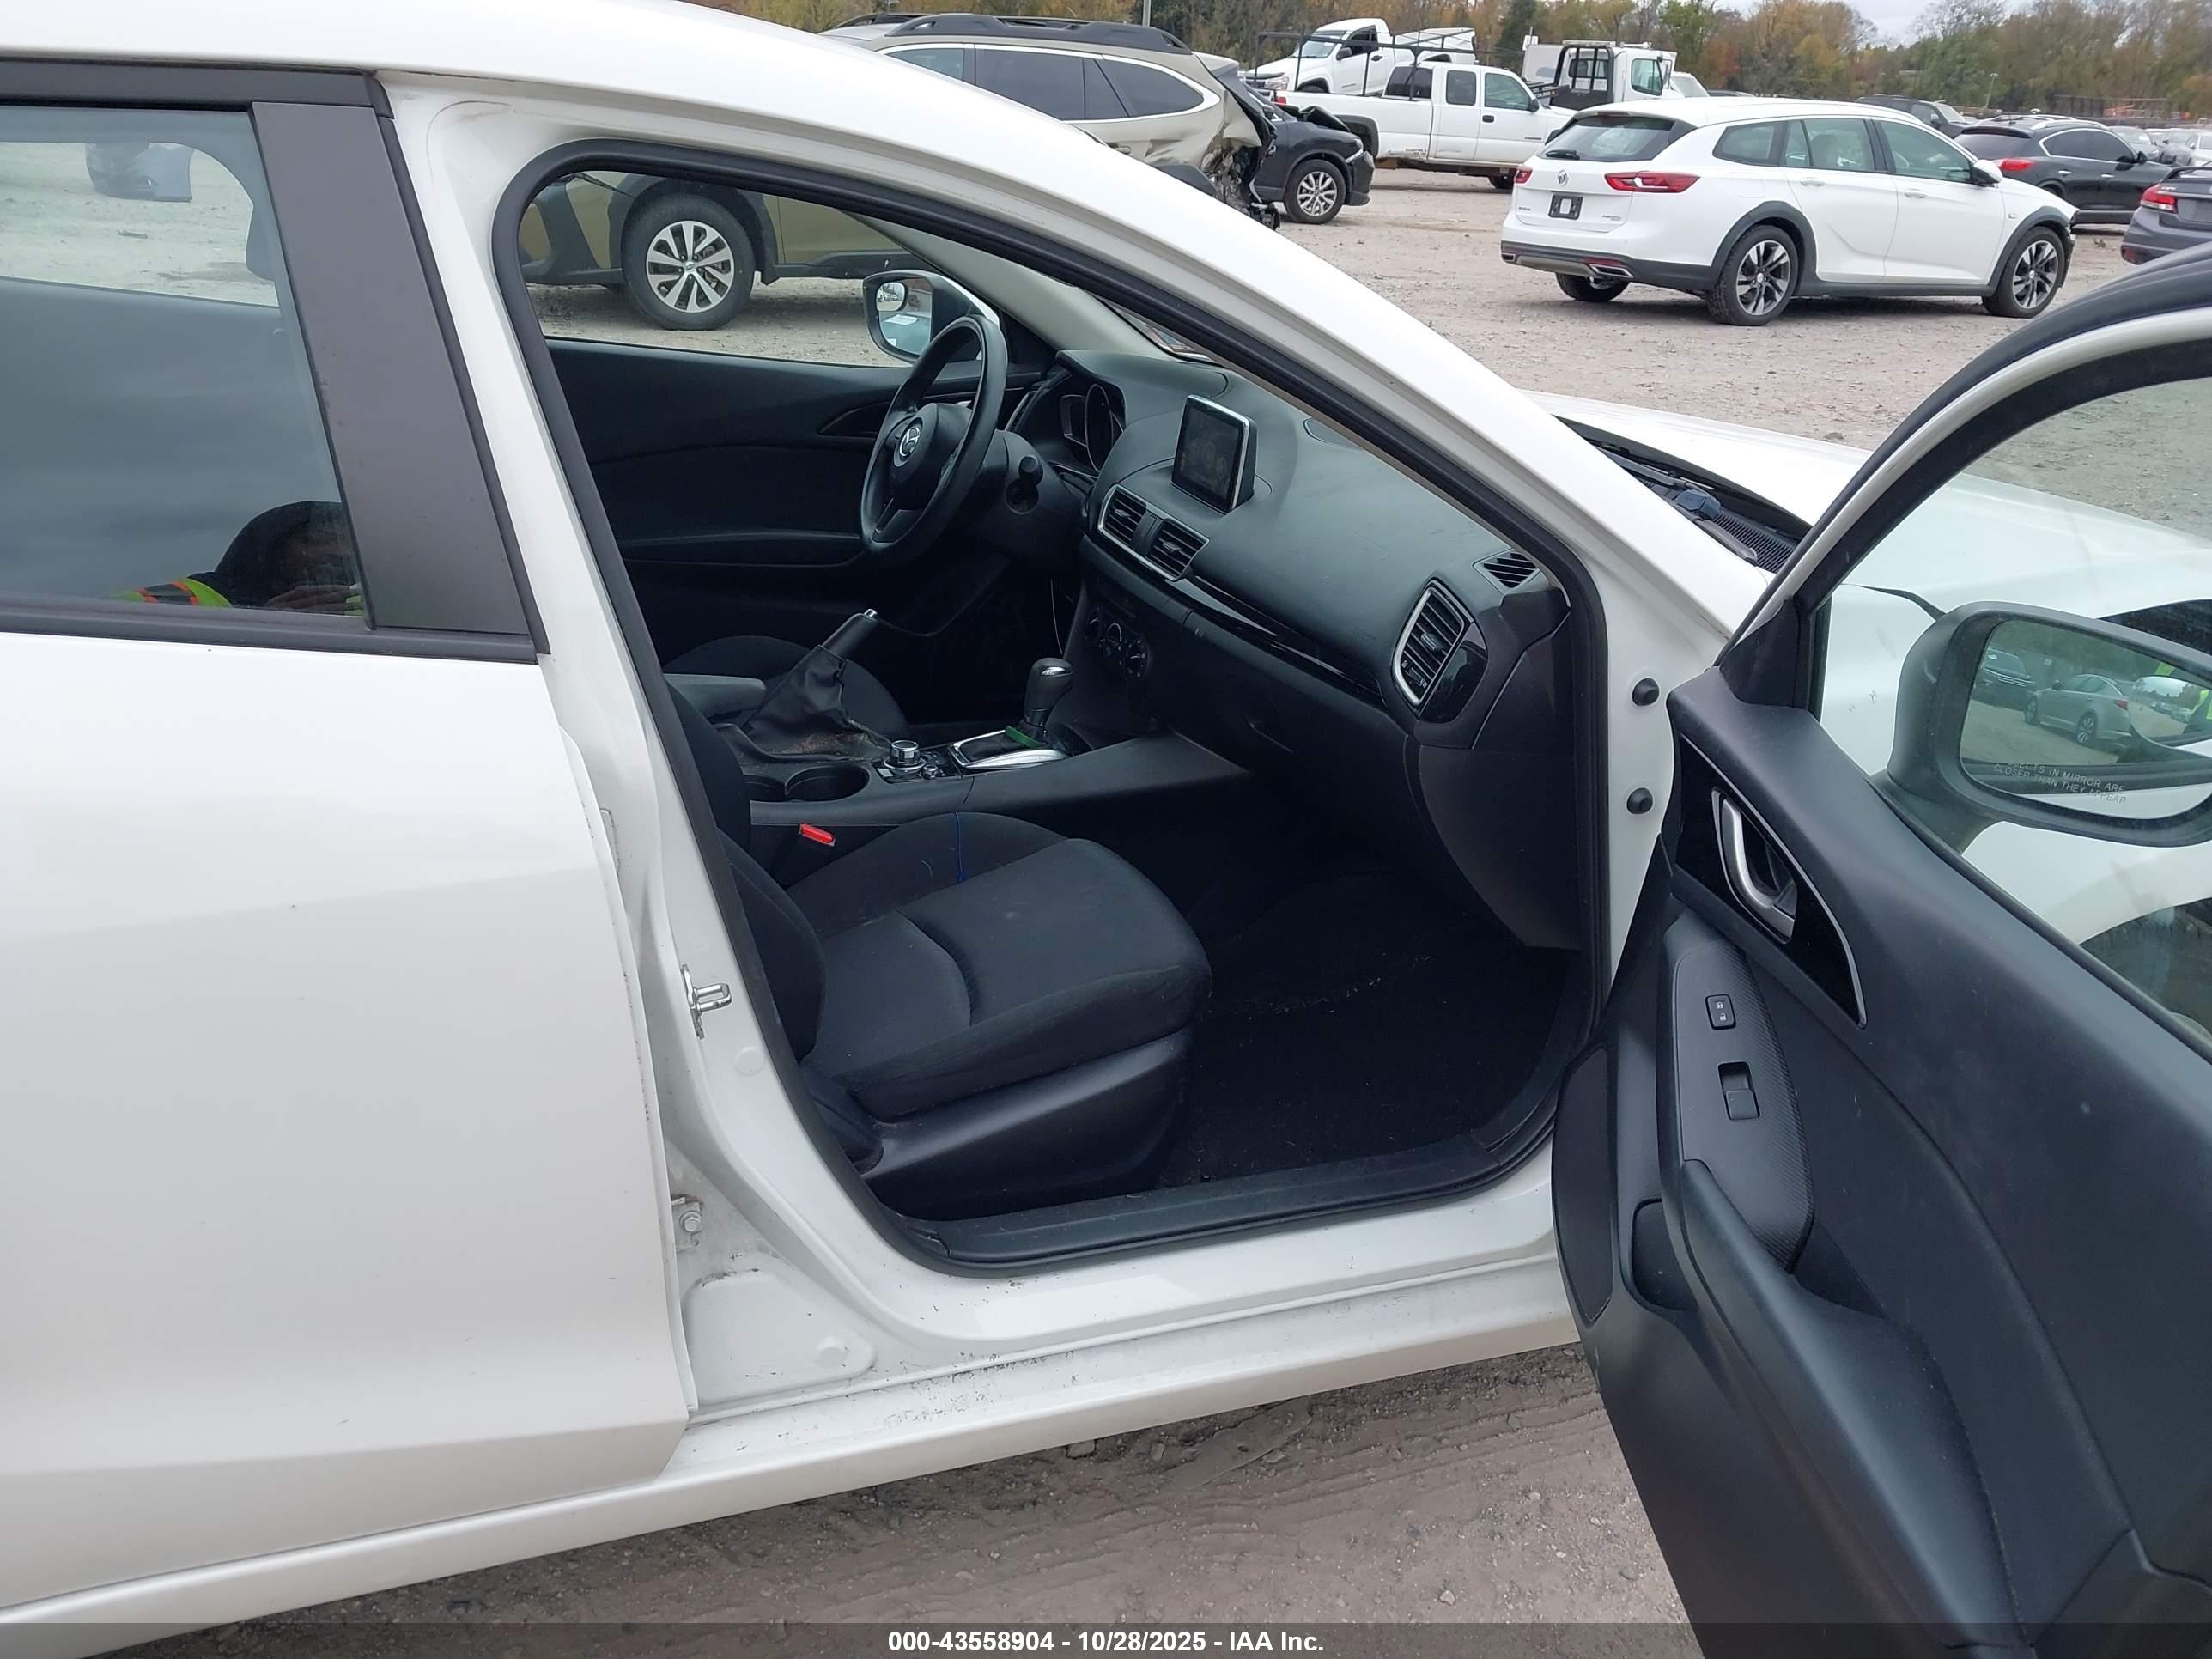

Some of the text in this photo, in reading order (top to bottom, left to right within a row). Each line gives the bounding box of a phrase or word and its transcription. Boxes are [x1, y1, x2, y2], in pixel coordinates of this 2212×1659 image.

[1994, 764, 2127, 805] CLOSER THAN THEY APPEAR
[2049, 769, 2059, 777] IN
[2062, 772, 2101, 787] MIRROR
[2104, 783, 2125, 792] ARE
